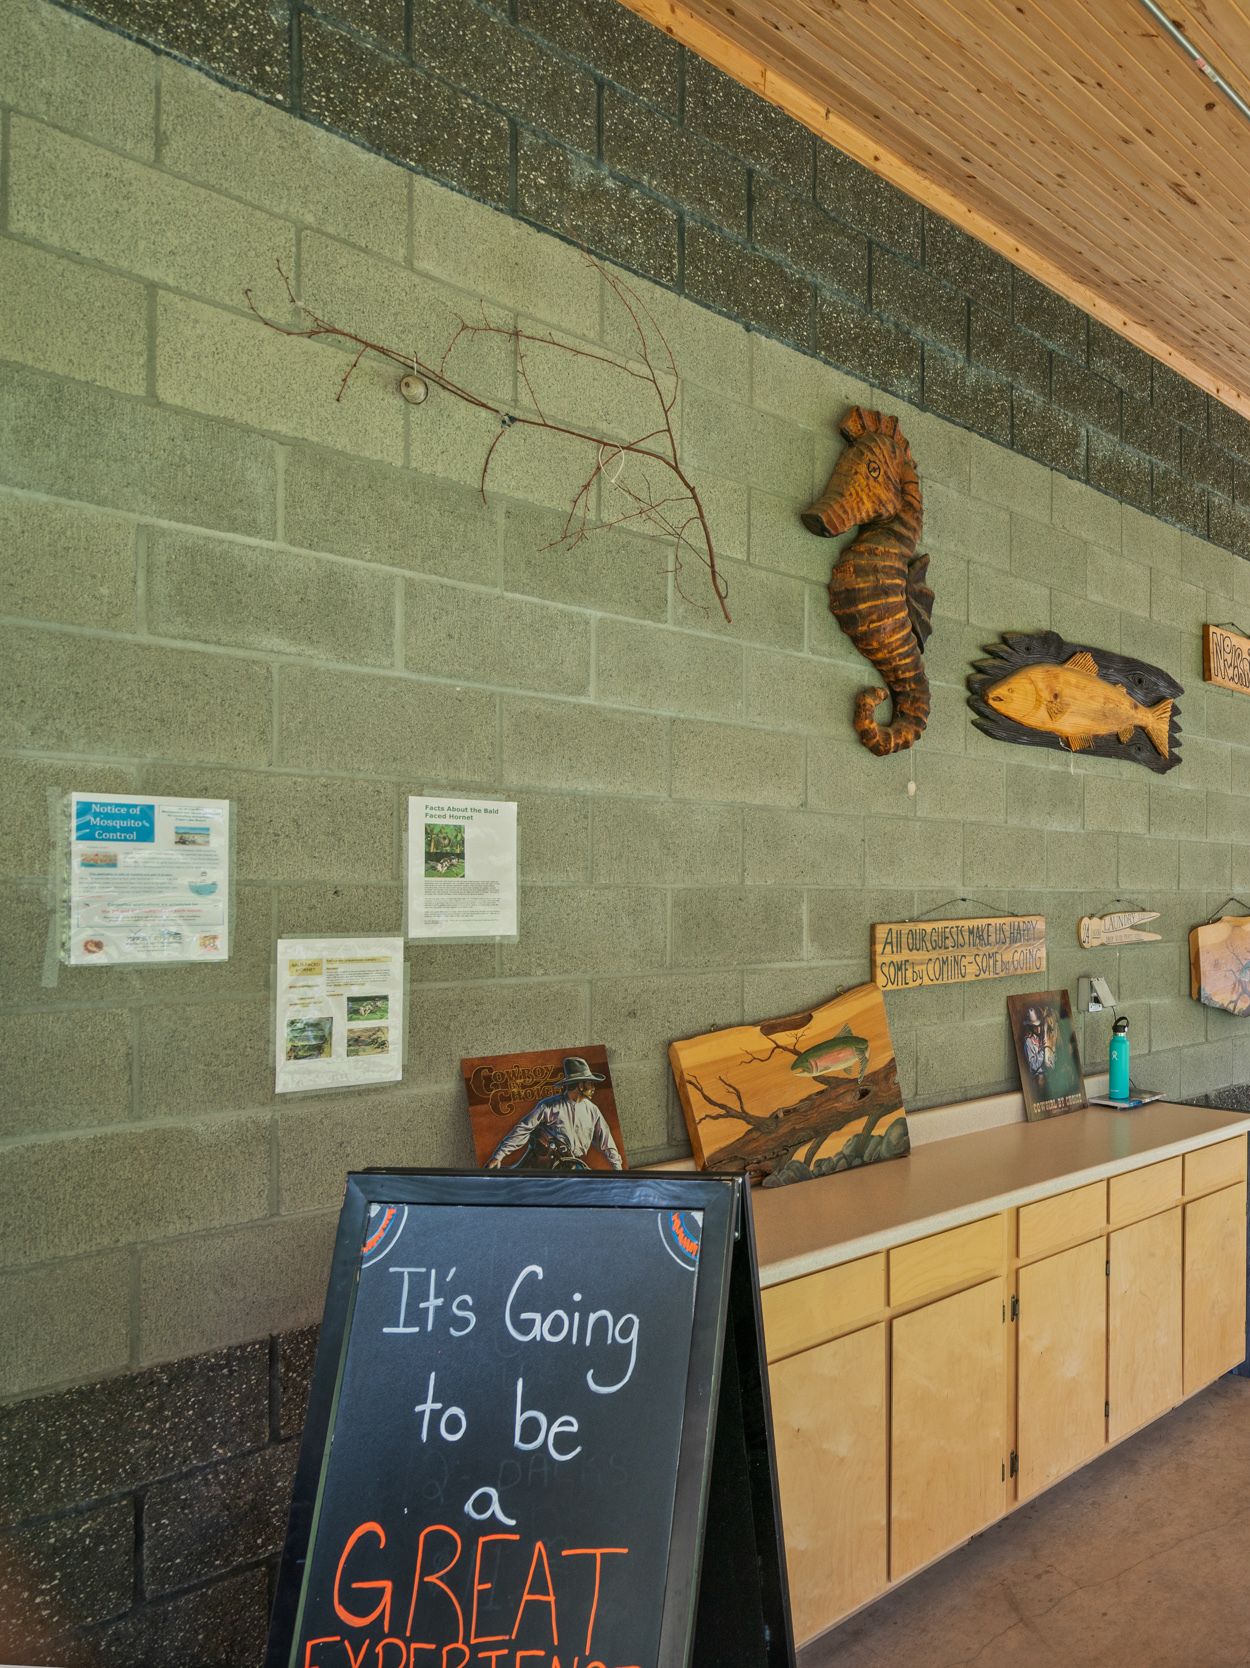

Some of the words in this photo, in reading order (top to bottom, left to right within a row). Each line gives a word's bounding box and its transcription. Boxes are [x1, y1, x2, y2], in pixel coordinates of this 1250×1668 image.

[89, 817, 142, 829] Mosquito
[92, 804, 127, 814] Notice
[129, 804, 141, 814] of
[449, 813, 474, 821] Hornet
[95, 830, 137, 840] Control
[907, 928, 930, 953] OUR
[930, 925, 967, 951] GUESTS
[968, 923, 992, 948] MAKE
[994, 922, 1007, 945] US
[1009, 920, 1039, 945] HAPPY
[1103, 912, 1136, 932] LAUNDRY
[880, 959, 910, 988] SOME
[912, 960, 924, 986] by
[1001, 954, 1010, 976] by
[382, 1265, 476, 1338] It's
[503, 1263, 641, 1395] Going
[414, 1371, 467, 1444] to
[513, 1378, 583, 1463] be
[464, 1485, 517, 1526] a
[332, 1521, 629, 1656] GREAT
